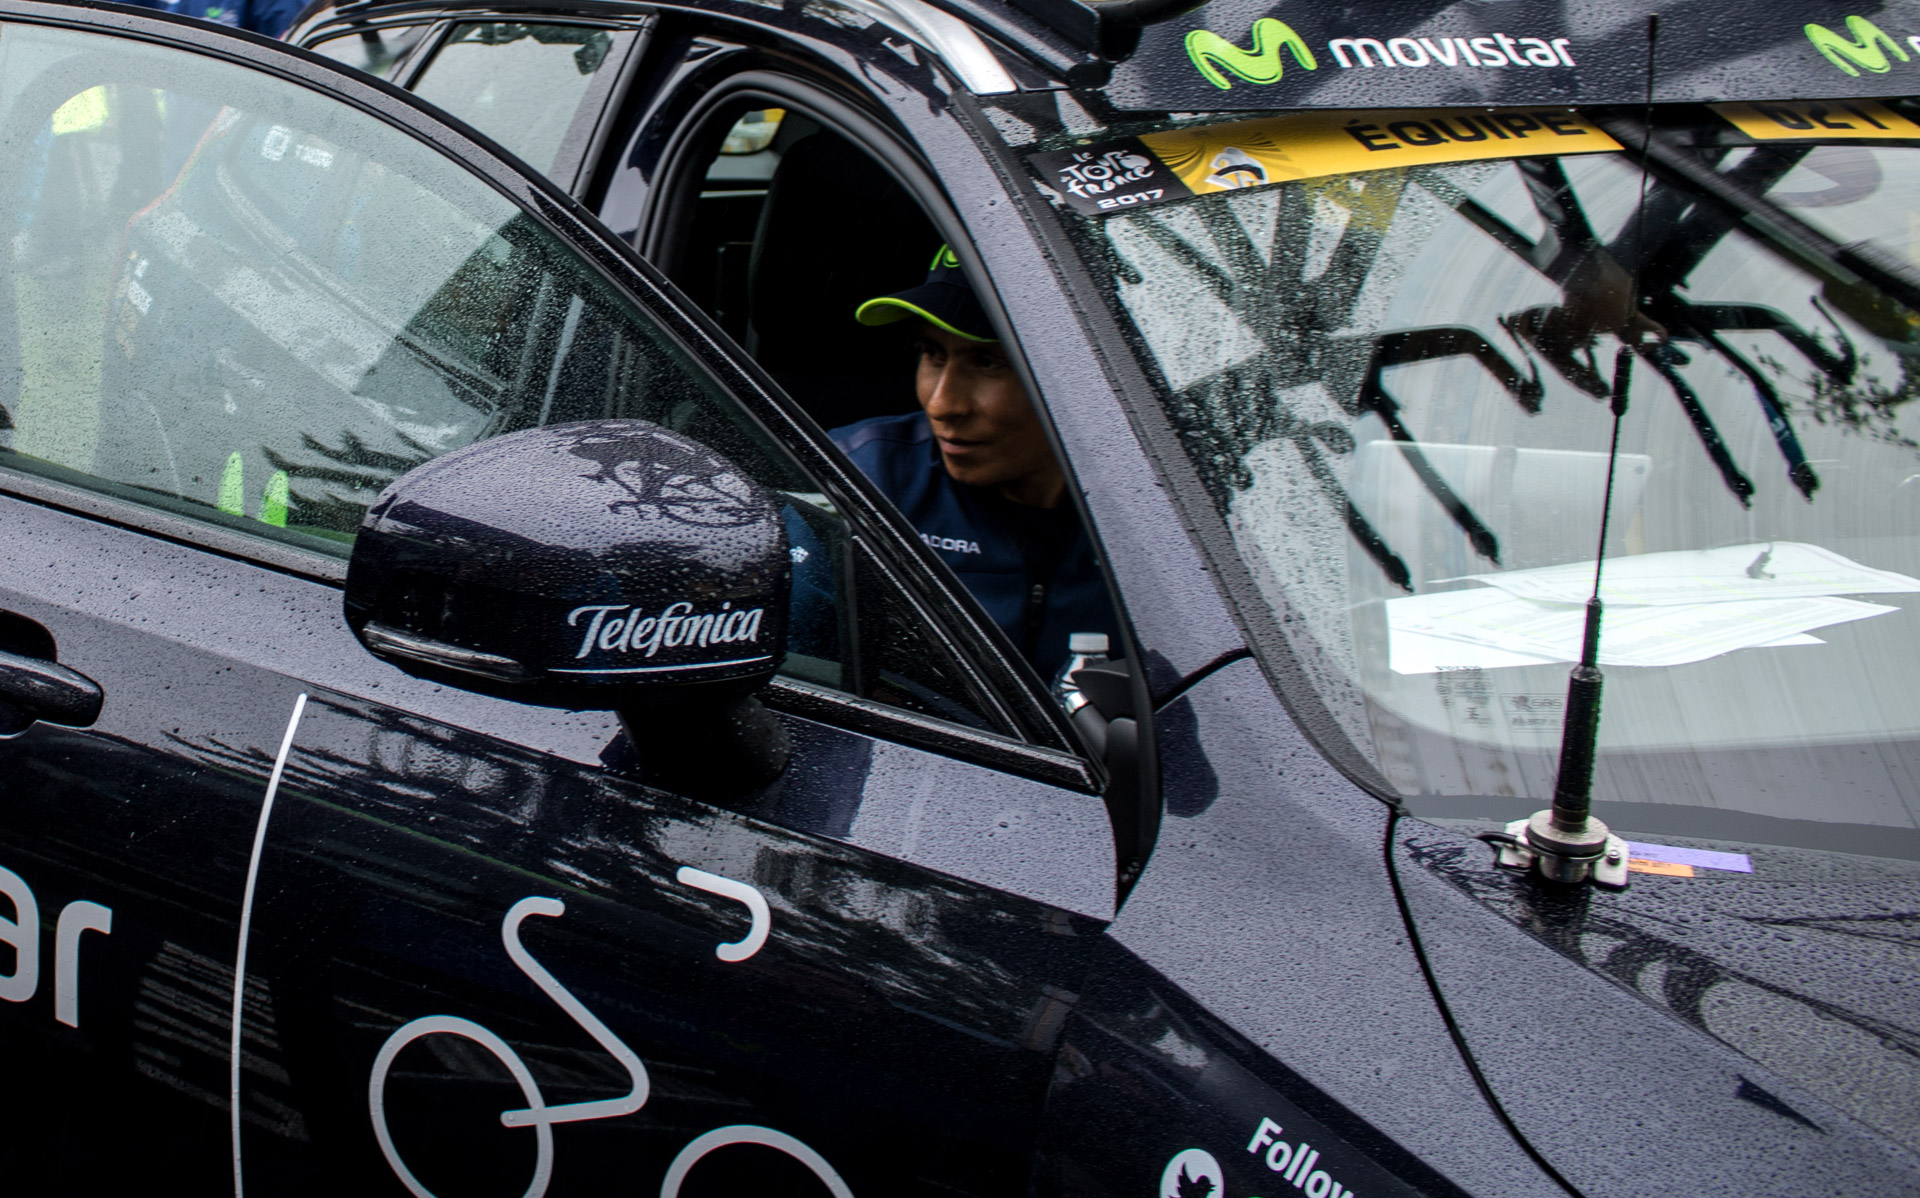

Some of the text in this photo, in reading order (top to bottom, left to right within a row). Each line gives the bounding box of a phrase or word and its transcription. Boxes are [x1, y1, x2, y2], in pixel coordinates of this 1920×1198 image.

[1328, 33, 1576, 68] movistar
[1343, 110, 1588, 152] ÉQUIPE
[1096, 188, 1165, 209] 2017
